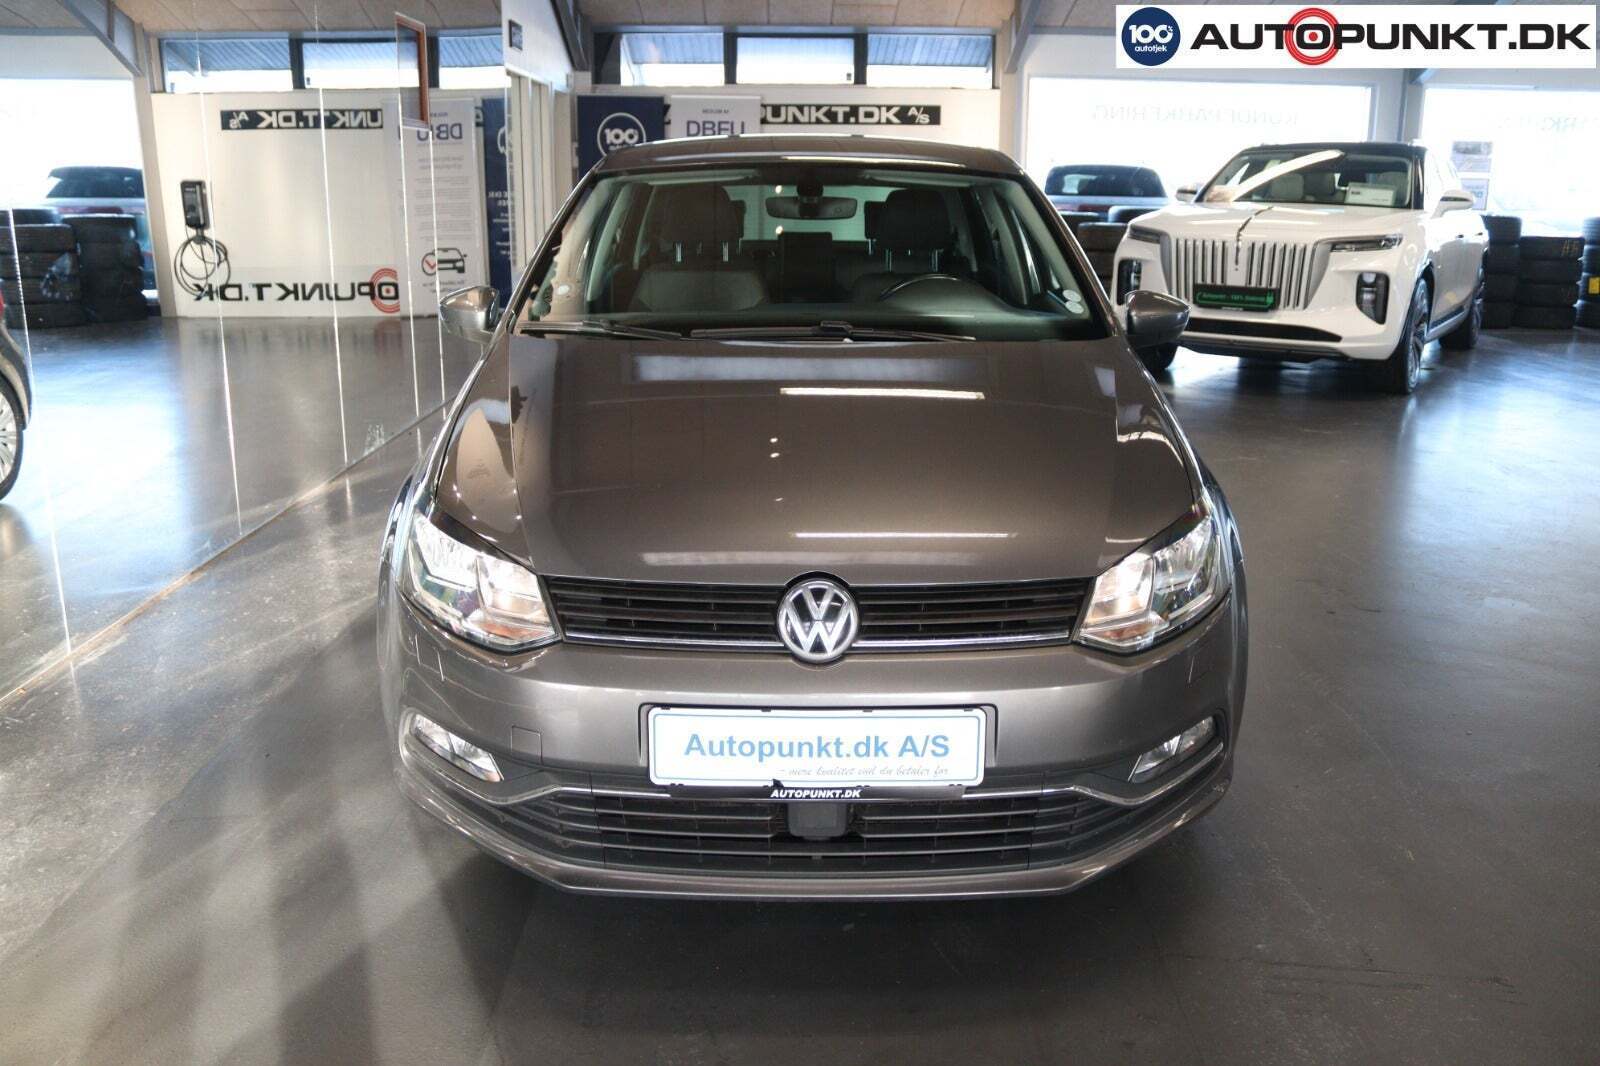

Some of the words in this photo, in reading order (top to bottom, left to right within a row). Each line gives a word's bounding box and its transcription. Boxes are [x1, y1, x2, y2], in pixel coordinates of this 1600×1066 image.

[907, 107, 930, 124] A/S
[684, 733, 889, 763] Autopunkt.dk
[898, 734, 950, 758] A/S
[770, 789, 862, 800] AUTOPUNKT.DK
